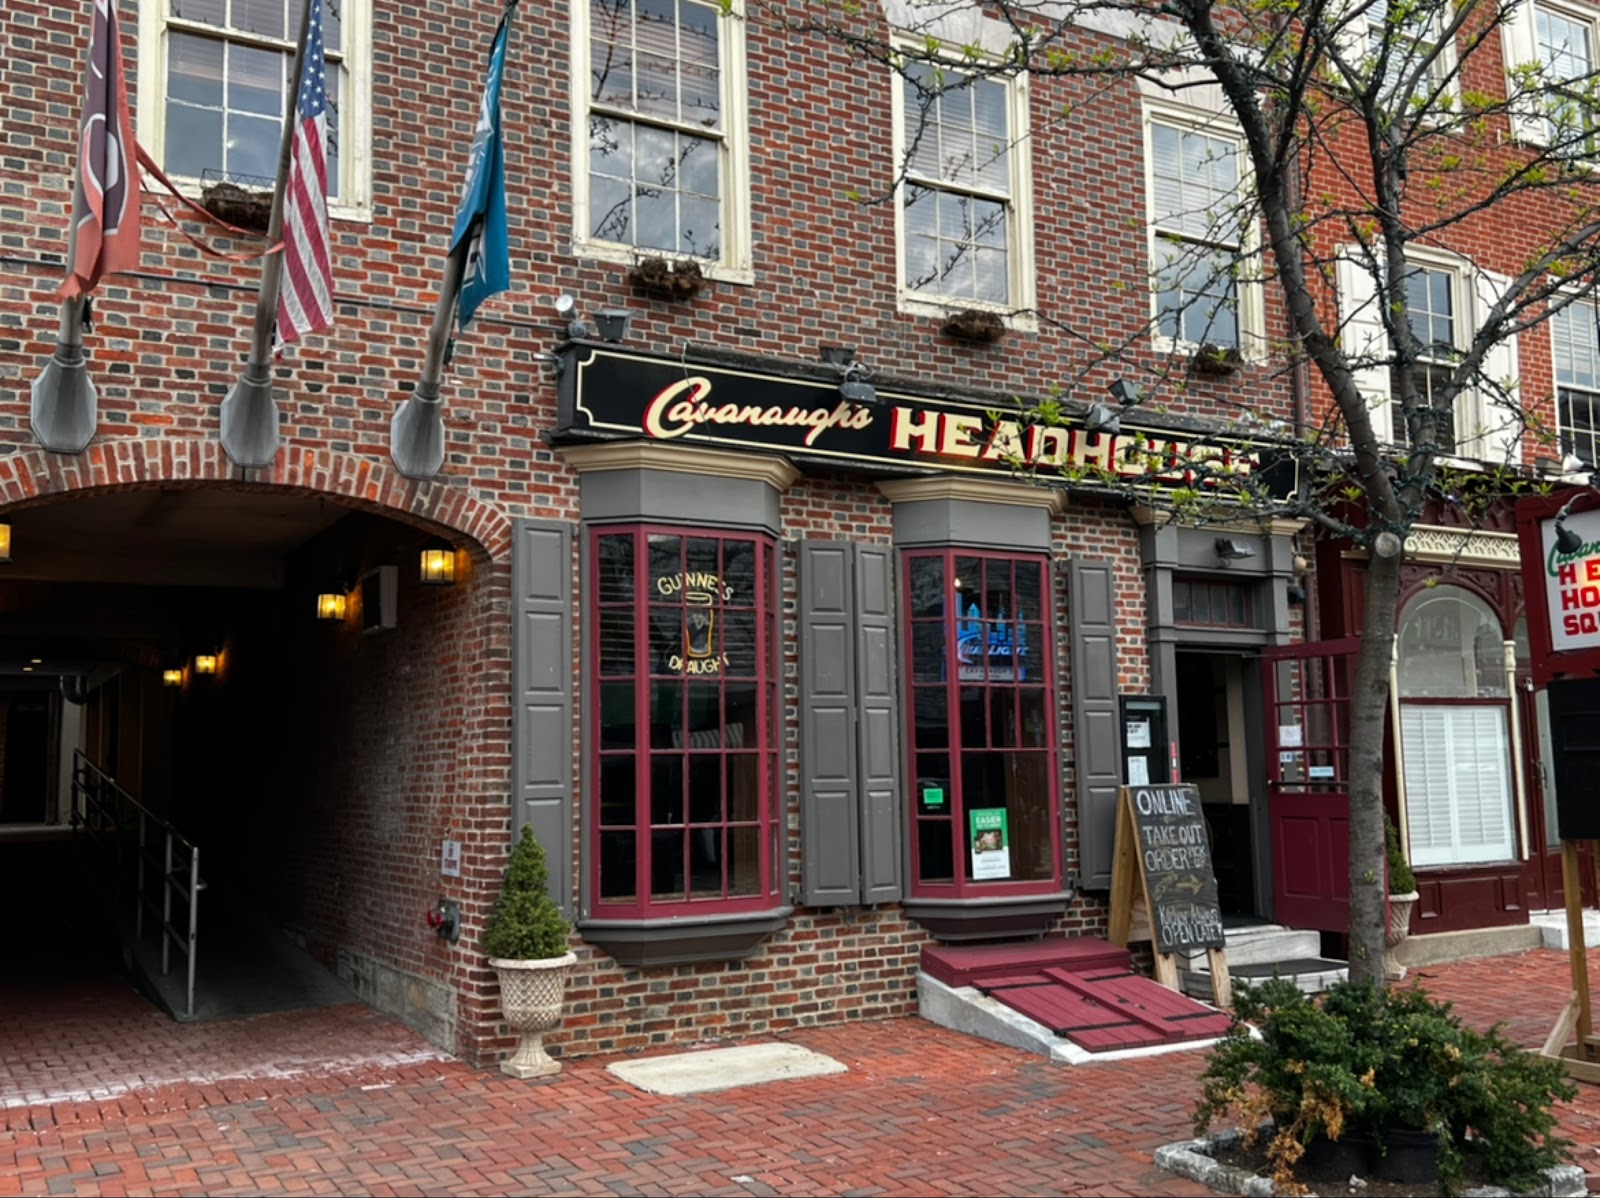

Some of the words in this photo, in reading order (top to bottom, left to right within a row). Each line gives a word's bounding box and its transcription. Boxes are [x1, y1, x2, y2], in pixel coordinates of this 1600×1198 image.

[889, 406, 1260, 486] HEADHOUSE
[657, 572, 734, 601] GUNNES
[1563, 612, 1600, 636] SQ
[1136, 788, 1196, 816] ONLINE
[1142, 825, 1179, 845] TAKE
[1179, 824, 1203, 845] OUT
[1145, 847, 1191, 871] ORDER
[1161, 921, 1194, 946] OPEN
